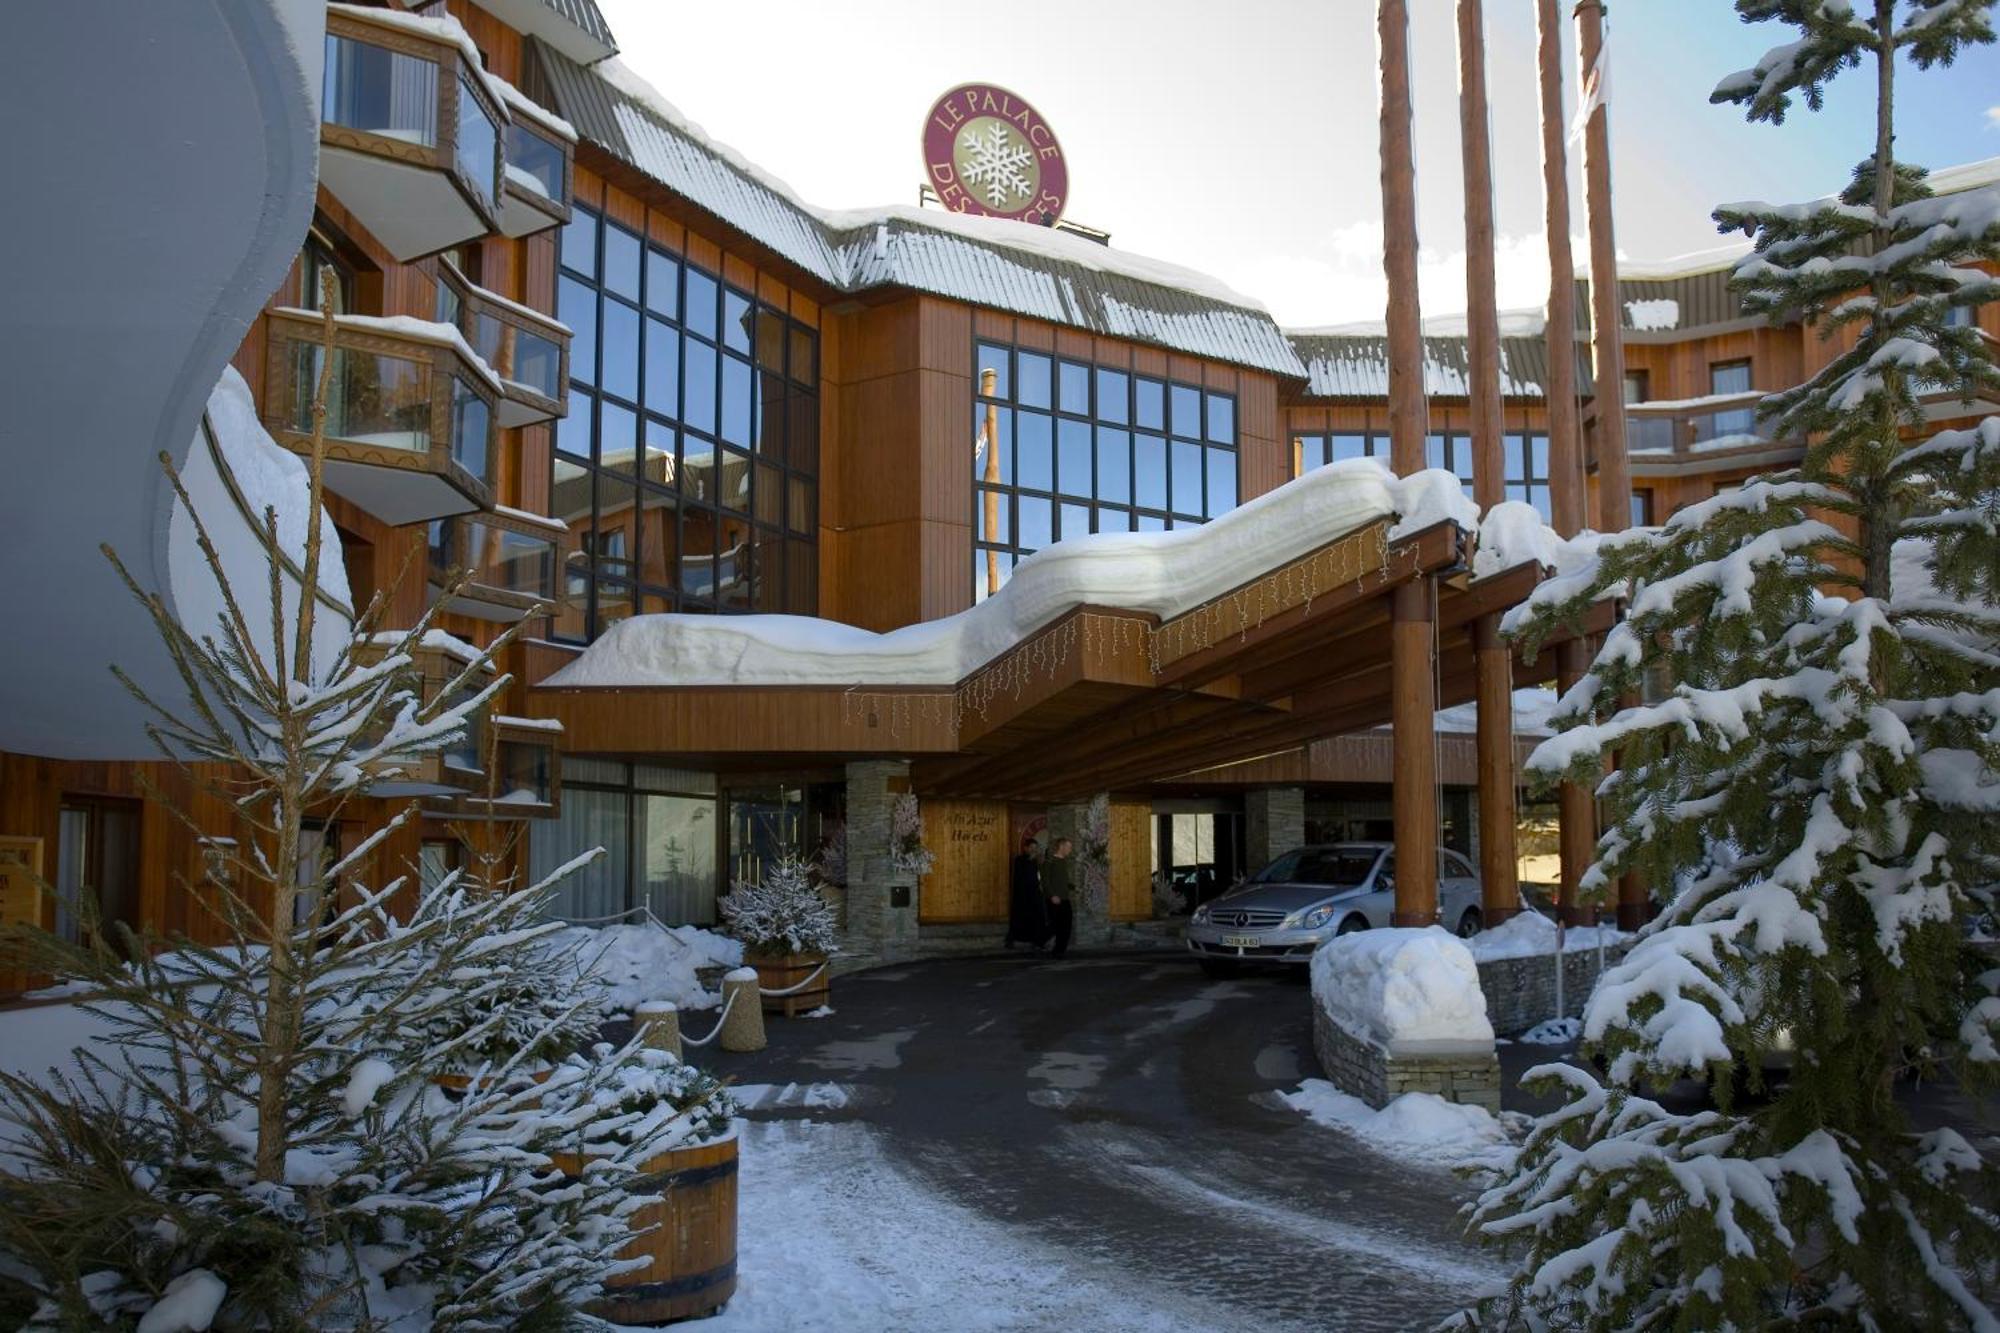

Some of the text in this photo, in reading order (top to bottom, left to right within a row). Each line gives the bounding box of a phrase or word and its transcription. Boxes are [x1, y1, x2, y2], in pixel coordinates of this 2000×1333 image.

[935, 90, 1059, 161] LE PALACE
[931, 162, 972, 213] DES
